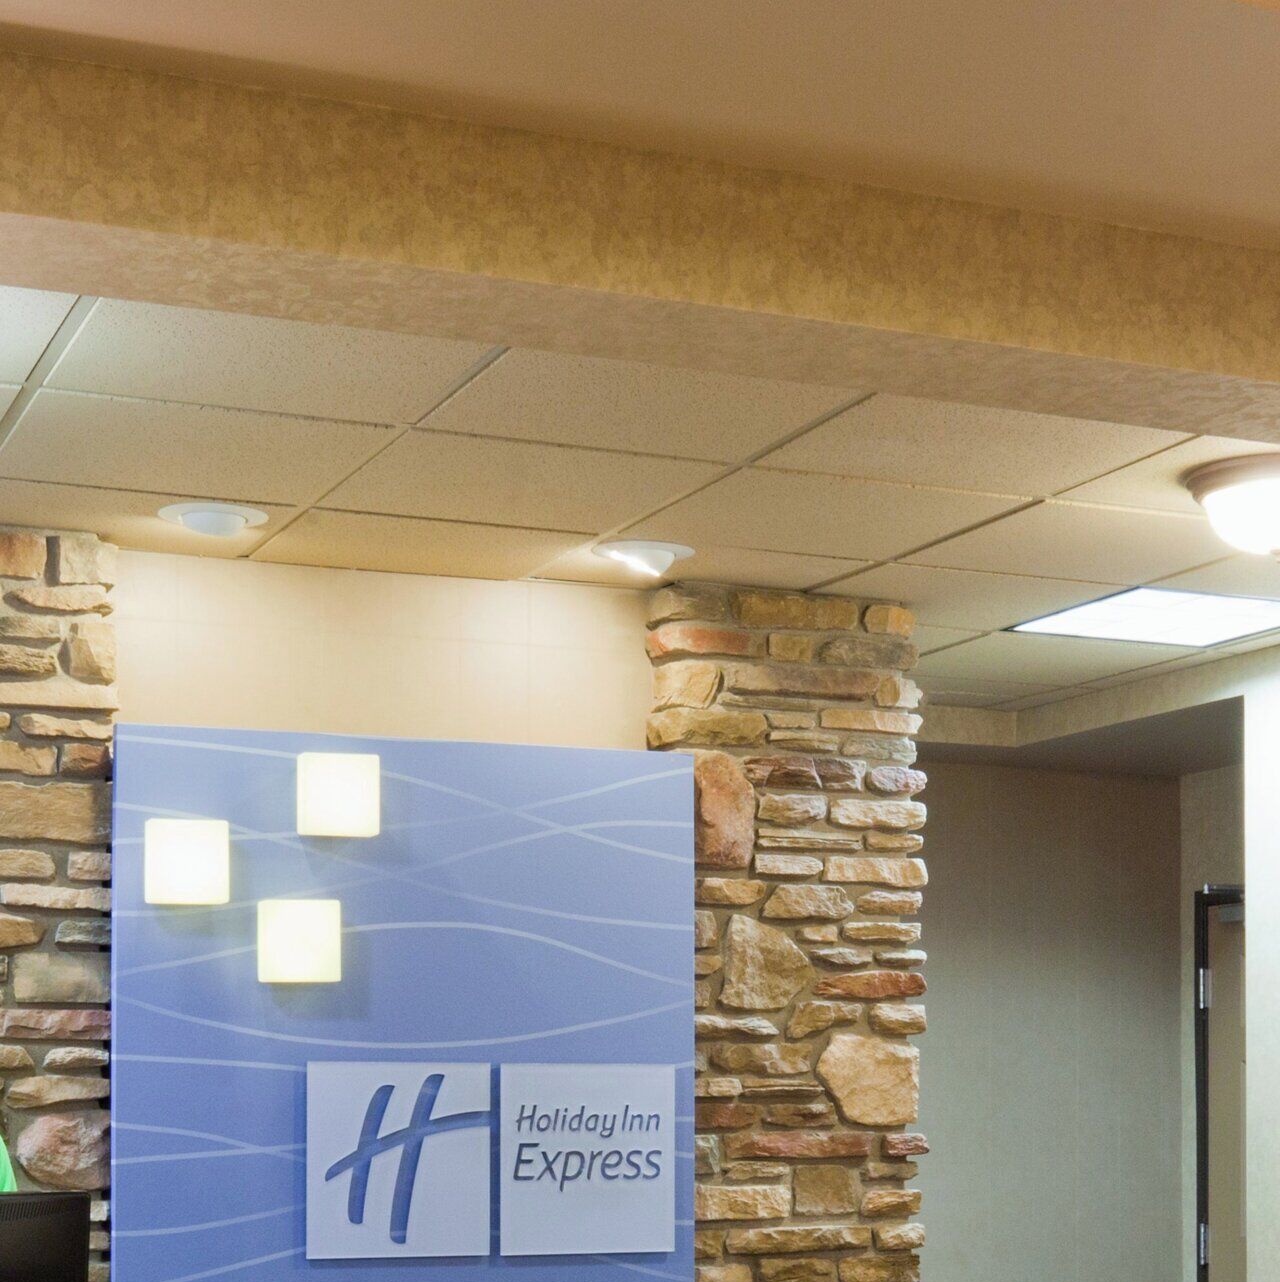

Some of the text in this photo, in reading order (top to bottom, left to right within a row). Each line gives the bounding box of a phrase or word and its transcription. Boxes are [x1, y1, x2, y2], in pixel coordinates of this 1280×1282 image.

[516, 1104, 661, 1138] Holiday Inn
[513, 1142, 662, 1193] Express
